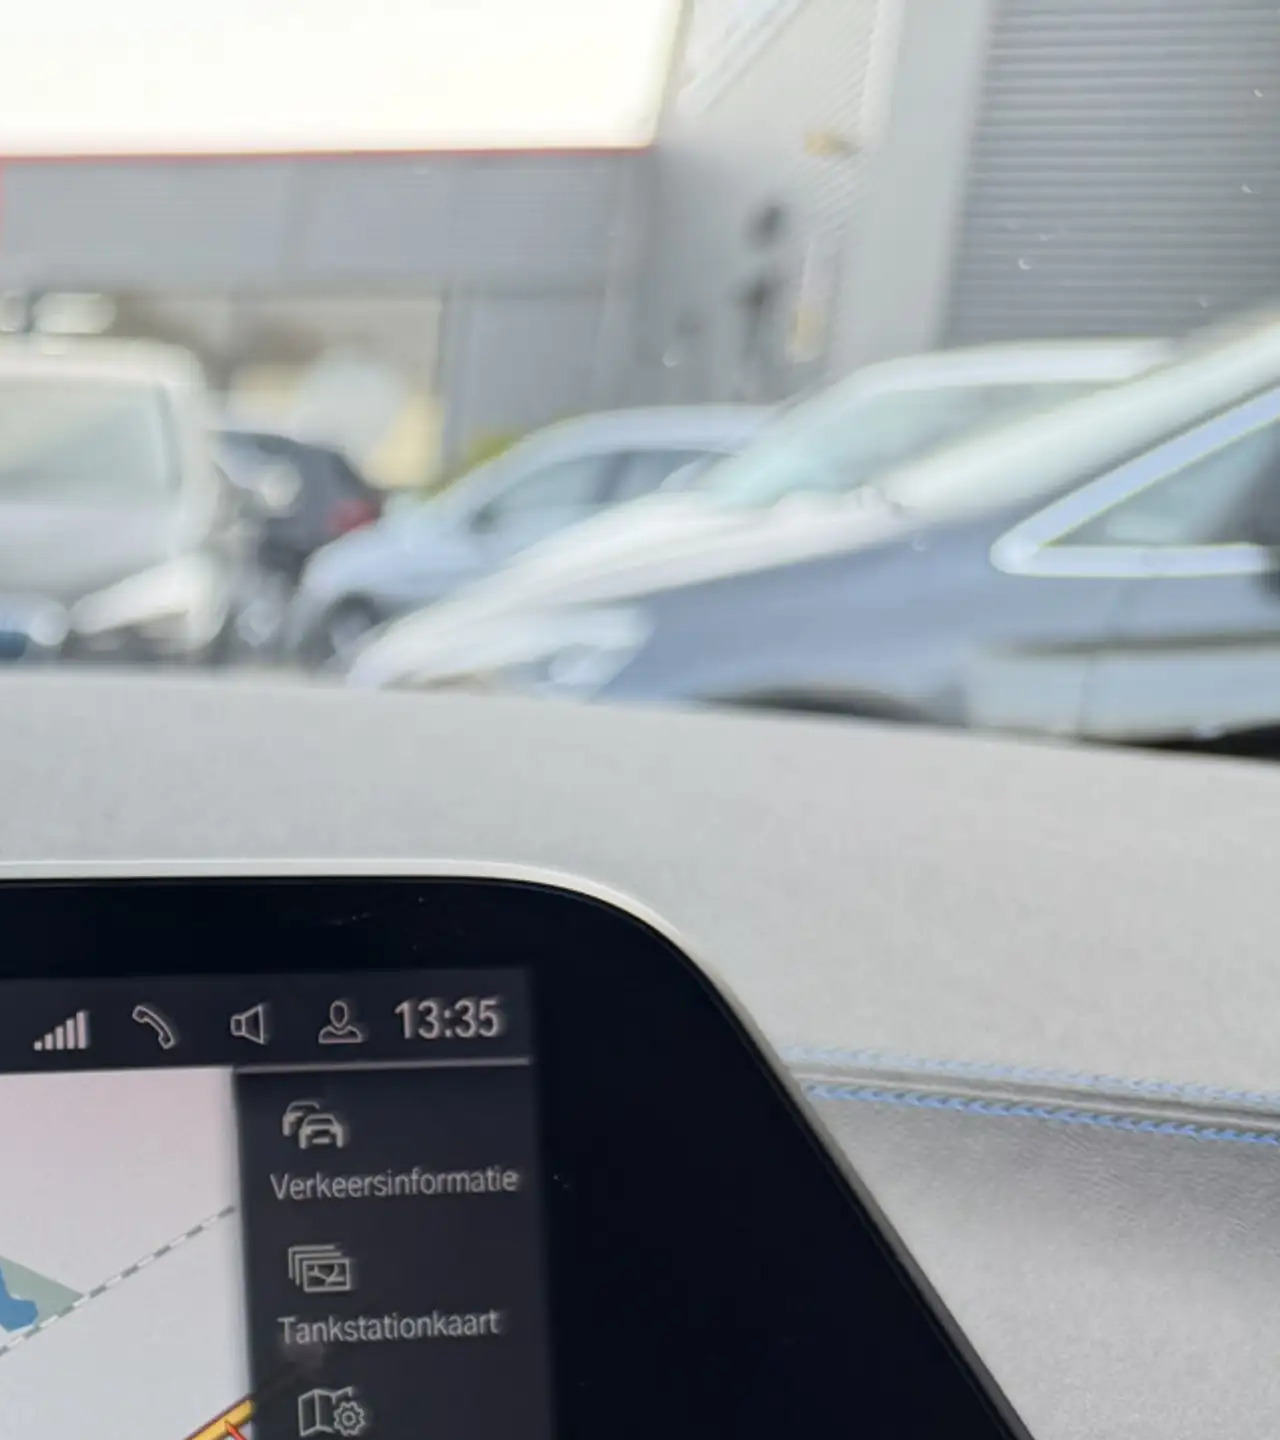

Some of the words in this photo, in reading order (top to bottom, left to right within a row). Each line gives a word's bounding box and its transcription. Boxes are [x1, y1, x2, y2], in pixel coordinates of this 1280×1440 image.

[394, 998, 502, 1040] 13:35
[269, 1167, 521, 1201] Verkeersinformatie
[278, 1310, 502, 1346] Tankstationkaart
